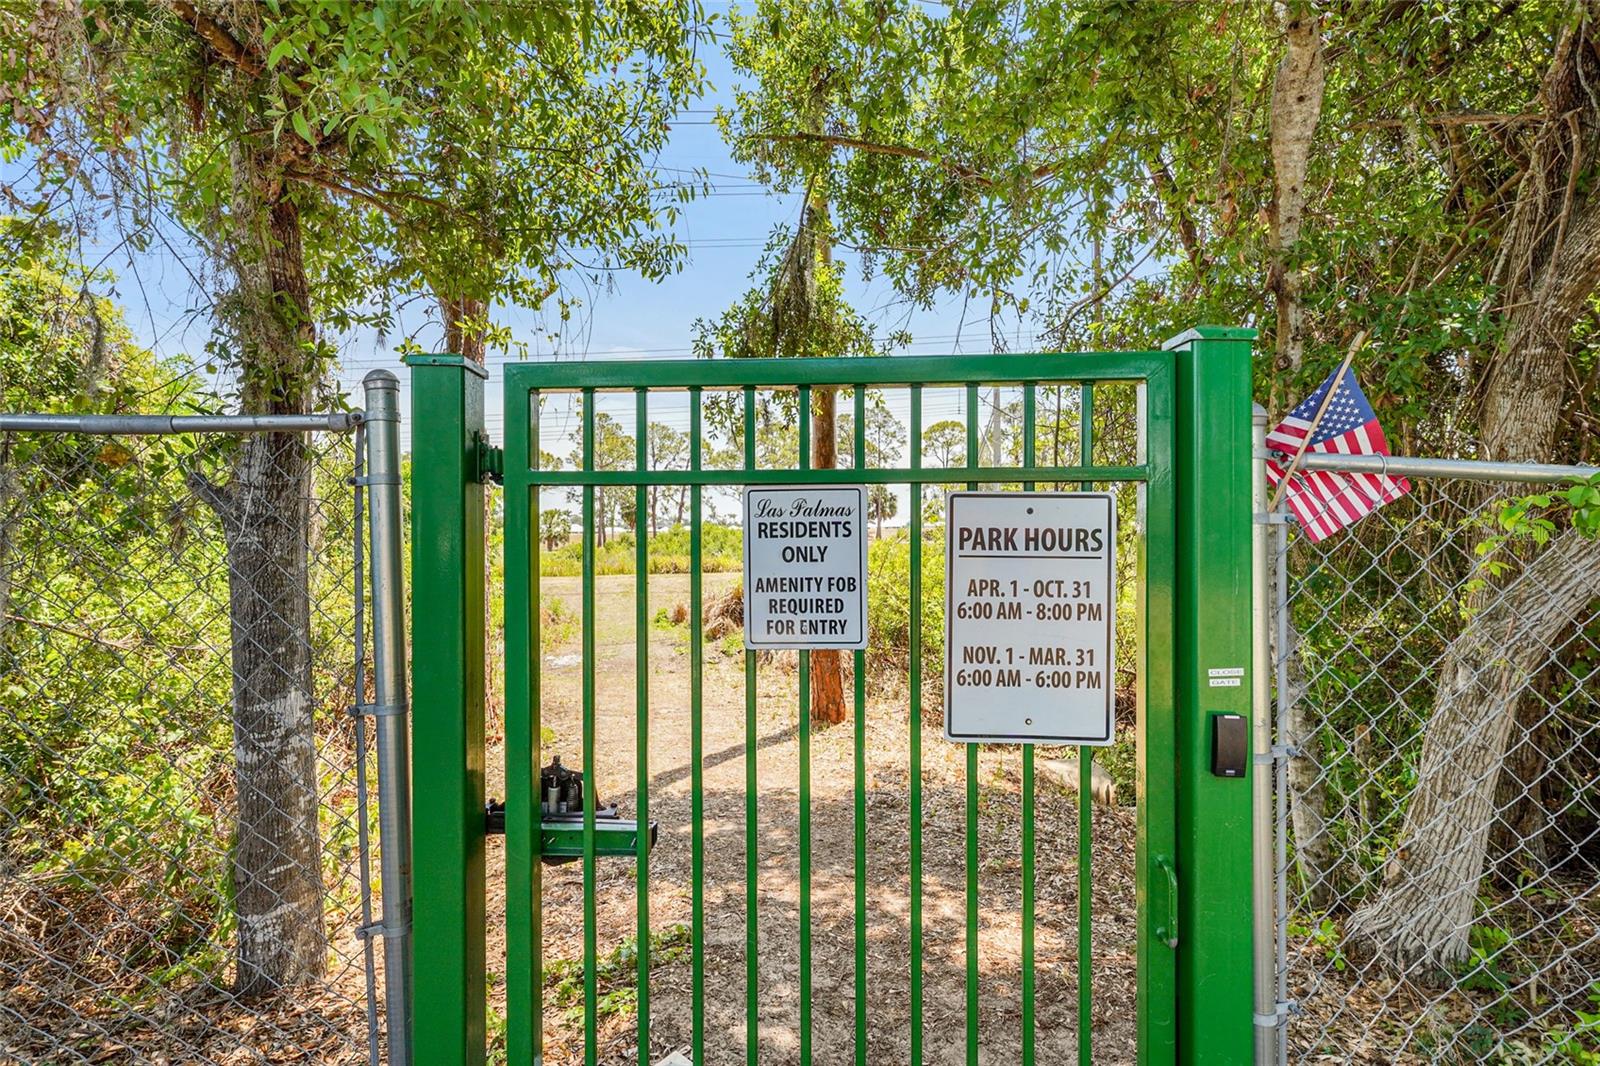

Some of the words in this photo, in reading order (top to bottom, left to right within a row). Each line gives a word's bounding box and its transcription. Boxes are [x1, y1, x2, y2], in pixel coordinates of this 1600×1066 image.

[754, 498, 787, 518] Las
[789, 497, 856, 518] Palmas
[758, 521, 852, 539] RESIDENTS
[959, 527, 1018, 551] PARK
[1024, 527, 1103, 552] HOURS
[782, 546, 828, 563] ONLY
[755, 577, 823, 593] AMENITY
[828, 577, 857, 592] FOB
[967, 579, 1005, 597] APR.
[1010, 580, 1018, 597] 1
[1033, 580, 1068, 598] OCT.
[1072, 581, 1091, 599] 31
[769, 598, 844, 615] REQUIRED
[957, 602, 992, 620] 6:00
[996, 602, 1022, 620] AM
[1036, 603, 1072, 621] 8:00
[1076, 603, 1102, 621] PM
[766, 619, 795, 635] FOR
[800, 619, 848, 635] ENTRY
[963, 646, 1000, 664] NOV.
[1005, 647, 1013, 665] 1
[1029, 647, 1071, 666] MAR.
[1075, 648, 1094, 666] 31
[956, 669, 992, 687] 6:00
[995, 670, 1021, 687] AM
[1035, 670, 1071, 689] 6:00
[1076, 671, 1101, 689] PM
